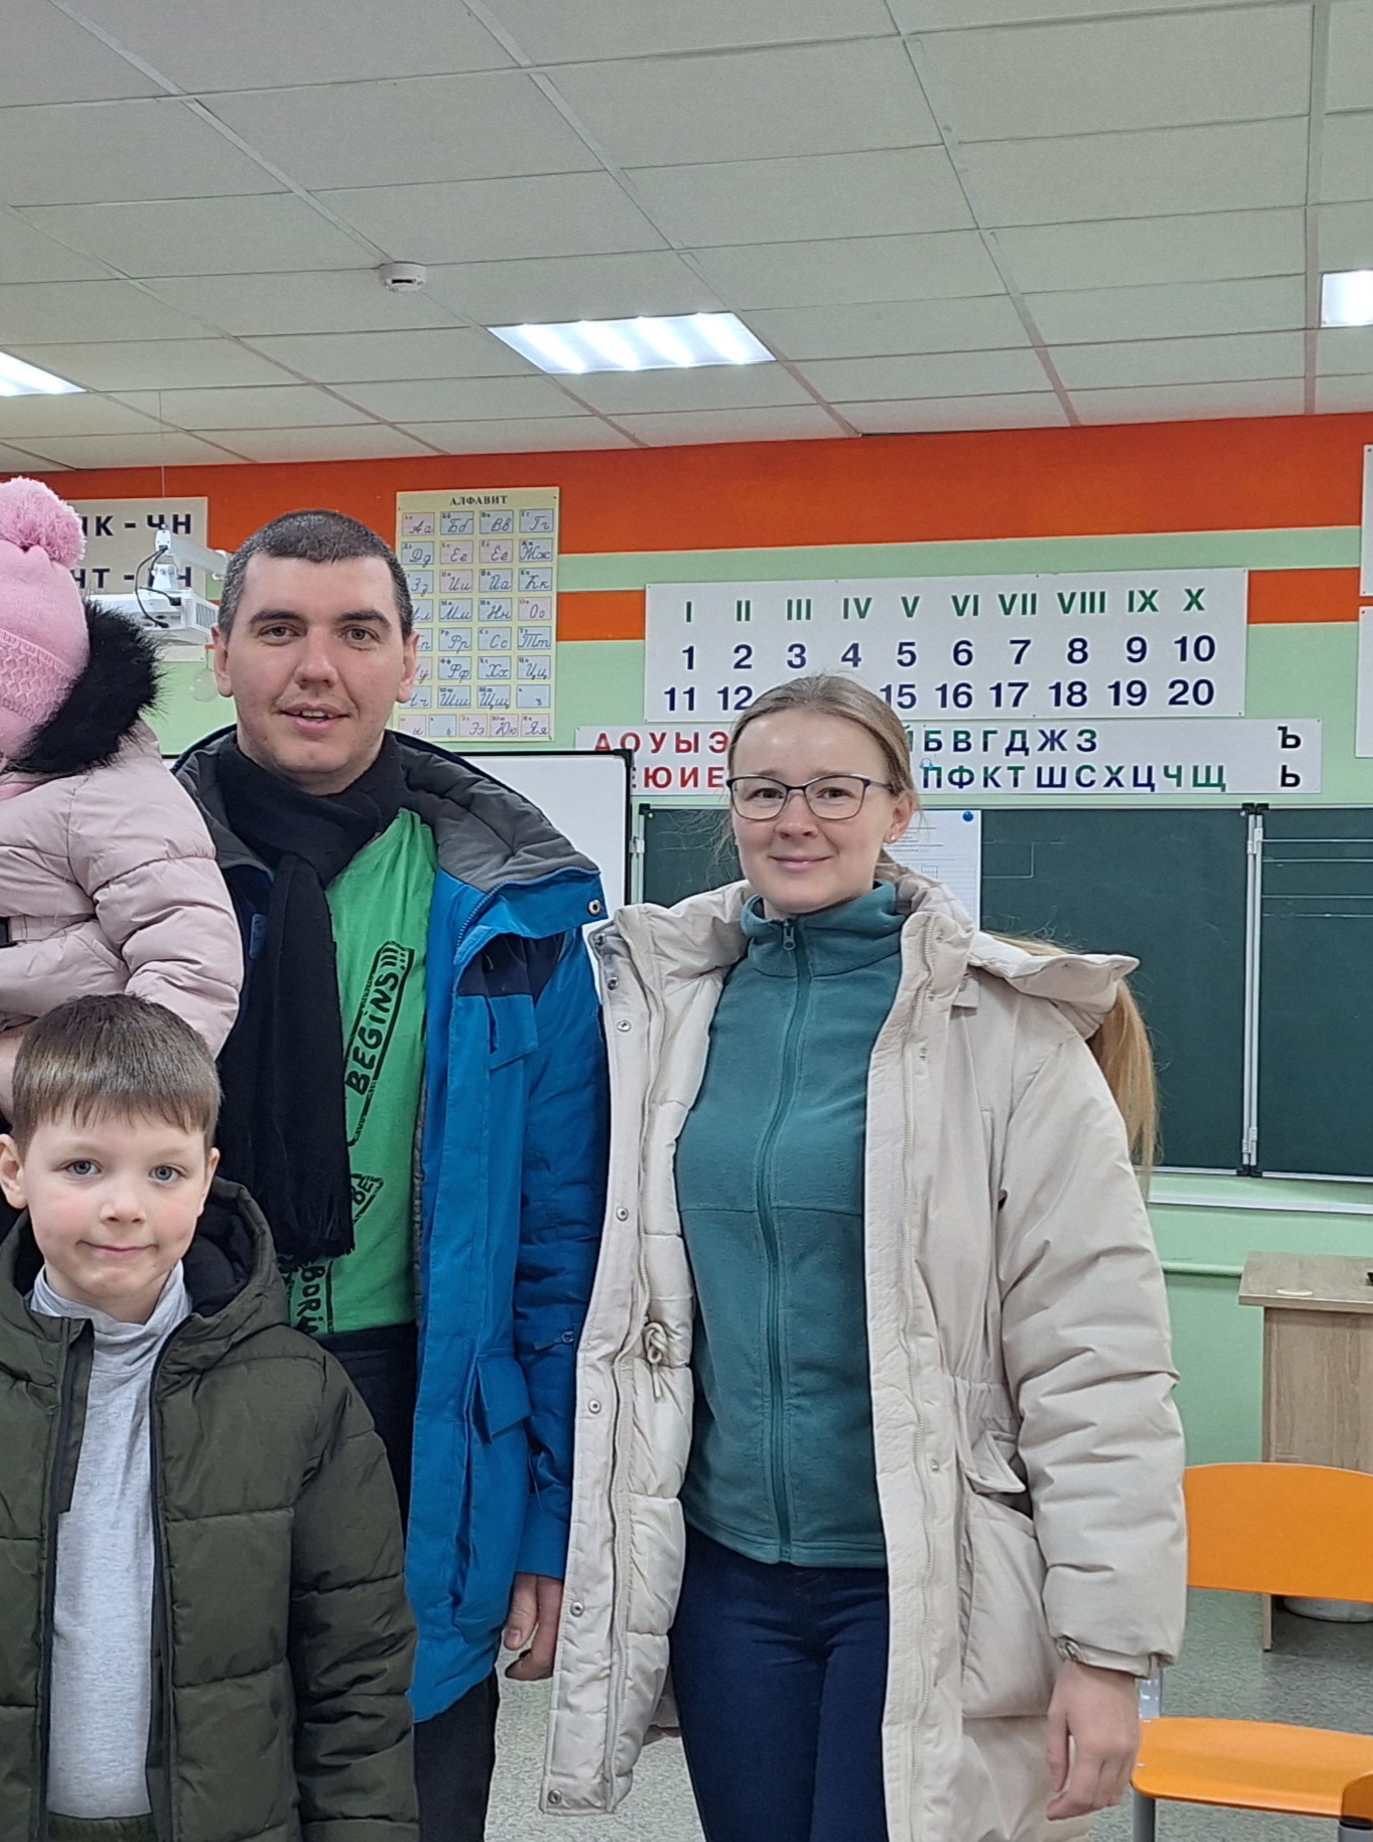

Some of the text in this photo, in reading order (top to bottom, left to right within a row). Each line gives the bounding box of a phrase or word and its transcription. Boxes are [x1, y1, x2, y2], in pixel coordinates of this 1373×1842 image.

[449, 495, 508, 506] АЛФАВИТ
[146, 513, 191, 535] ЧН
[686, 587, 1205, 623] I II III IV V VI VII VIII IX X
[681, 634, 1216, 670] 1 2 3 4 5 6 7 8 9 10
[664, 678, 1215, 712] 11 12 15 16 17 18 19 20
[1277, 725, 1302, 749] Ъ
[1280, 764, 1301, 788] Ь
